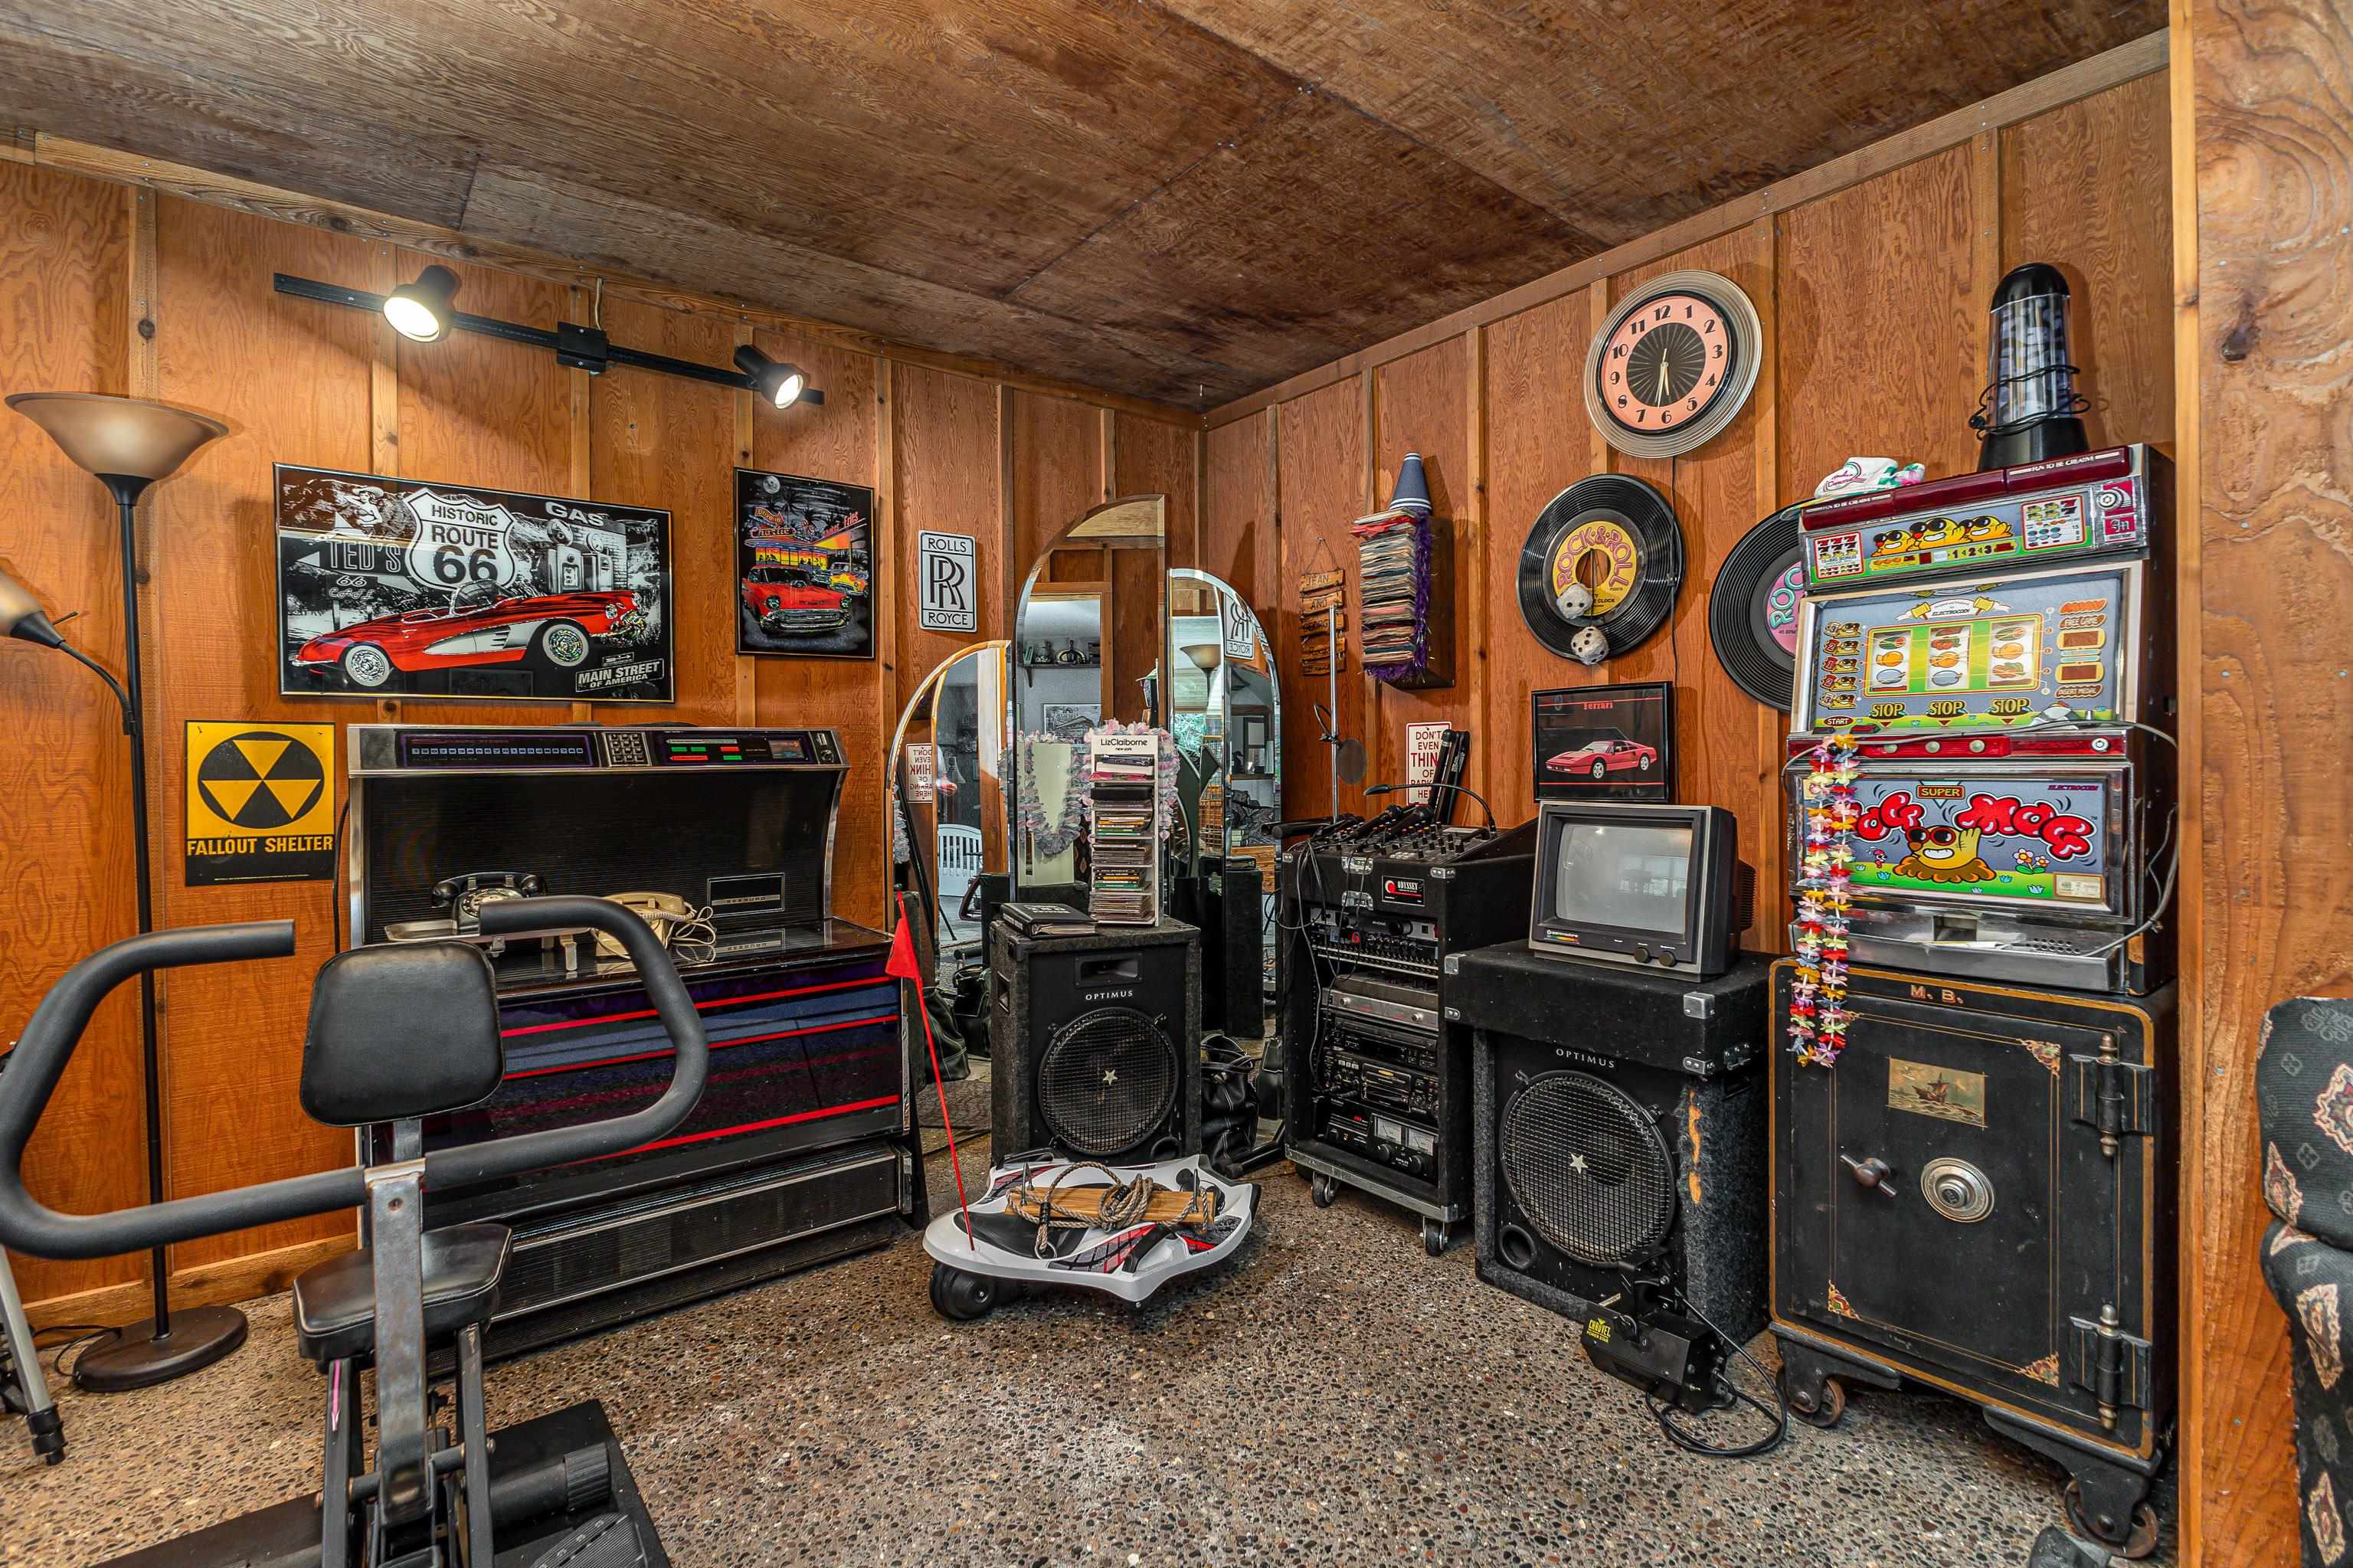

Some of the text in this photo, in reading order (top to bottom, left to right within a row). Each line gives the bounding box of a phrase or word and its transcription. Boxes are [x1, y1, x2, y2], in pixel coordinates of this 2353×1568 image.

[1653, 305, 1672, 321] 12
[1685, 305, 1692, 319] 1
[1630, 319, 1645, 335] 11
[1703, 319, 1716, 334] 2
[1612, 343, 1628, 359] 10
[1712, 344, 1723, 358] 3
[1610, 372, 1620, 385] 9
[1705, 373, 1716, 387] 4
[1618, 394, 1627, 409] 8
[1687, 398, 1697, 411] 5
[1635, 409, 1646, 423] 7
[1661, 411, 1672, 424] 6
[432, 505, 498, 526] HISTORIC
[545, 502, 604, 526] GAS
[432, 524, 499, 549] ROUTE
[928, 538, 966, 553] ROLLS
[1953, 545, 1992, 558] 1 2 3
[326, 538, 401, 572] TED'S
[1556, 526, 1594, 589] ROCK
[1605, 529, 1632, 587] ROLL
[434, 545, 498, 584] 66
[336, 575, 368, 587] 66
[1307, 574, 1330, 586] JEAN
[1769, 567, 1803, 630] ROC
[928, 611, 967, 625] ROYCE
[578, 661, 659, 684] MAIN STREET
[605, 673, 648, 686] AMERICA
[1583, 700, 1614, 711] Ferrari
[1872, 703, 1905, 717] STOP
[1929, 700, 1965, 716] STOP
[1992, 698, 2029, 714] STOP
[1416, 730, 1443, 741] DON'T
[1418, 741, 1439, 750] EVEN
[1411, 752, 1440, 768] THIN
[1422, 769, 1435, 778] OF
[1418, 790, 1428, 799] HE
[1921, 787, 1960, 797] SUPER
[1954, 792, 2097, 861] MOG
[188, 835, 333, 856] FALLOUT SHELTER
[1085, 990, 1134, 1001] OPTIMUS
[1910, 984, 1964, 1005] M. B.
[1556, 1048, 1615, 1069] OPTIMUS
